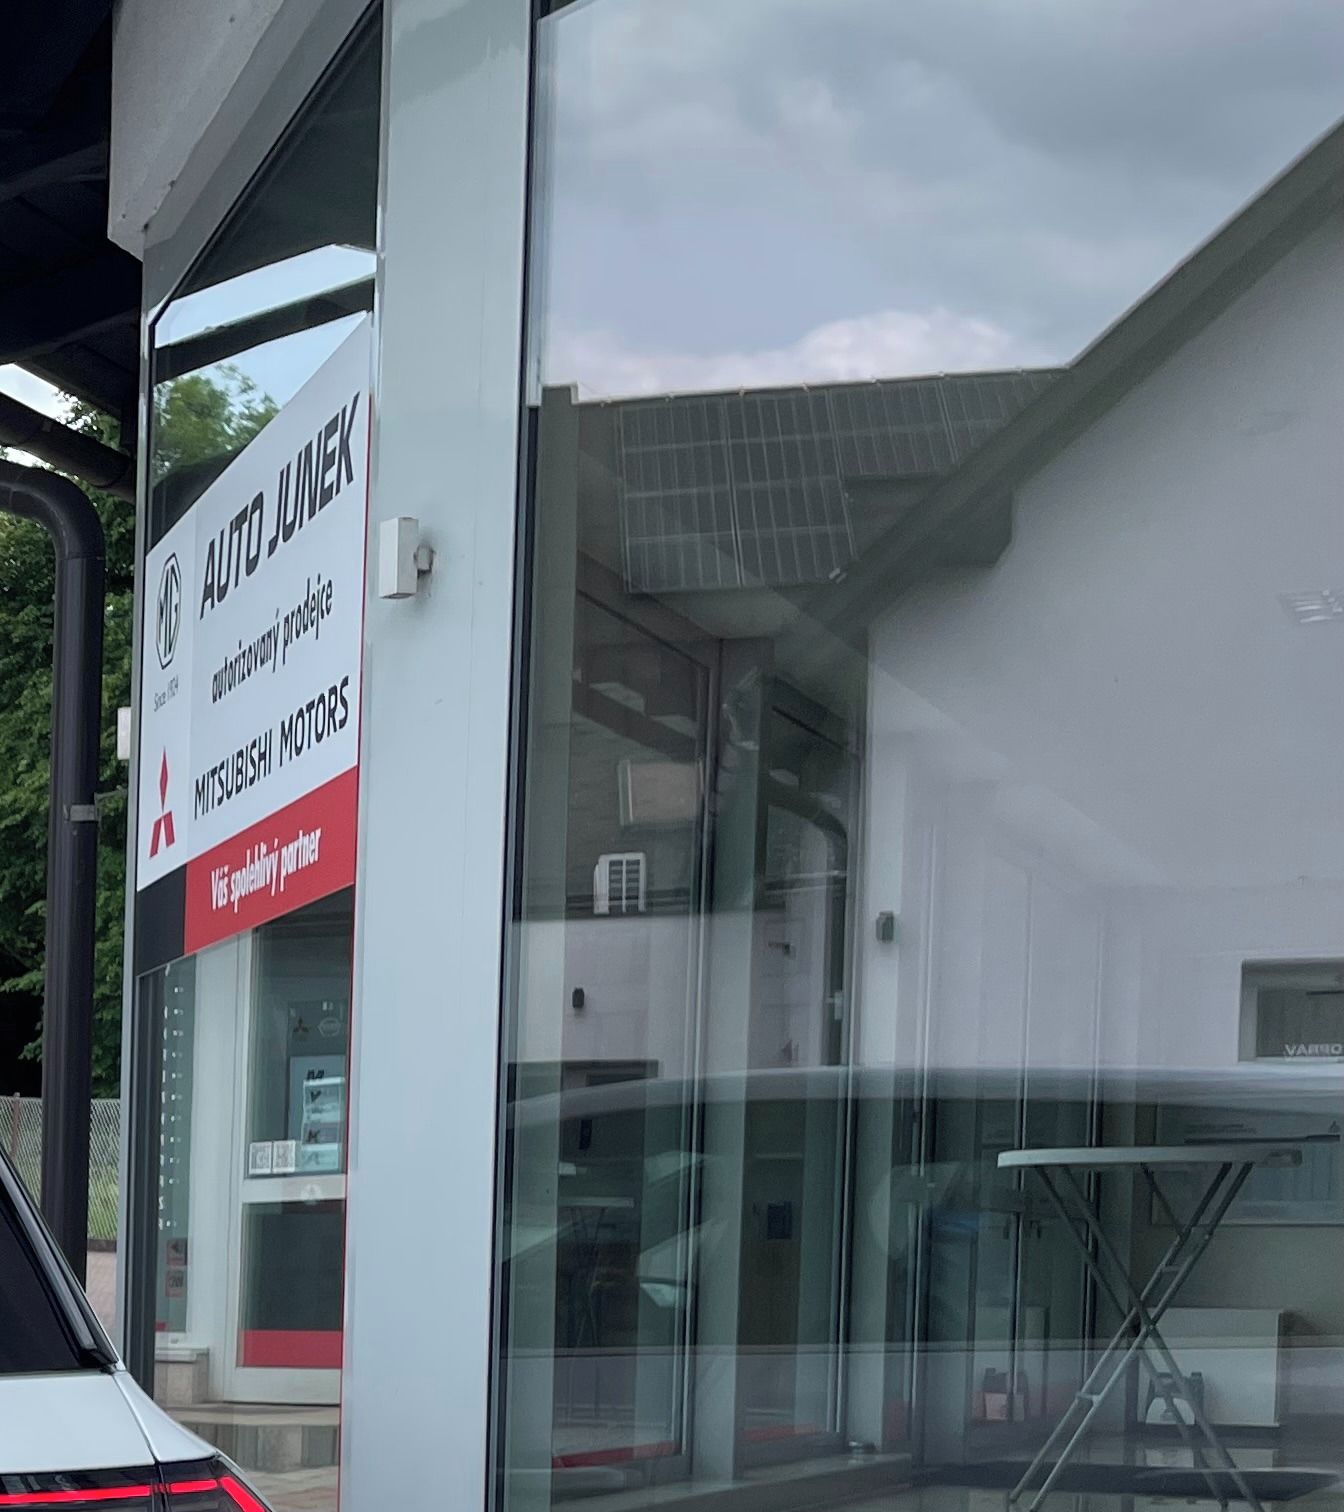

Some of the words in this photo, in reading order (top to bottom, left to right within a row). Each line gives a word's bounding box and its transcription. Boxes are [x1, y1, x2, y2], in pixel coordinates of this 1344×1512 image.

[199, 490, 264, 621] AUTO
[268, 390, 361, 560] JUNEK
[157, 559, 179, 660] MG
[212, 607, 280, 704] autorizovaný
[282, 572, 333, 666] prodejce
[194, 728, 272, 821] MITSUBISHI
[279, 675, 350, 768] MOTORS
[211, 864, 230, 912] Váš
[230, 837, 279, 914] spolehlivý
[279, 827, 322, 893] partner
